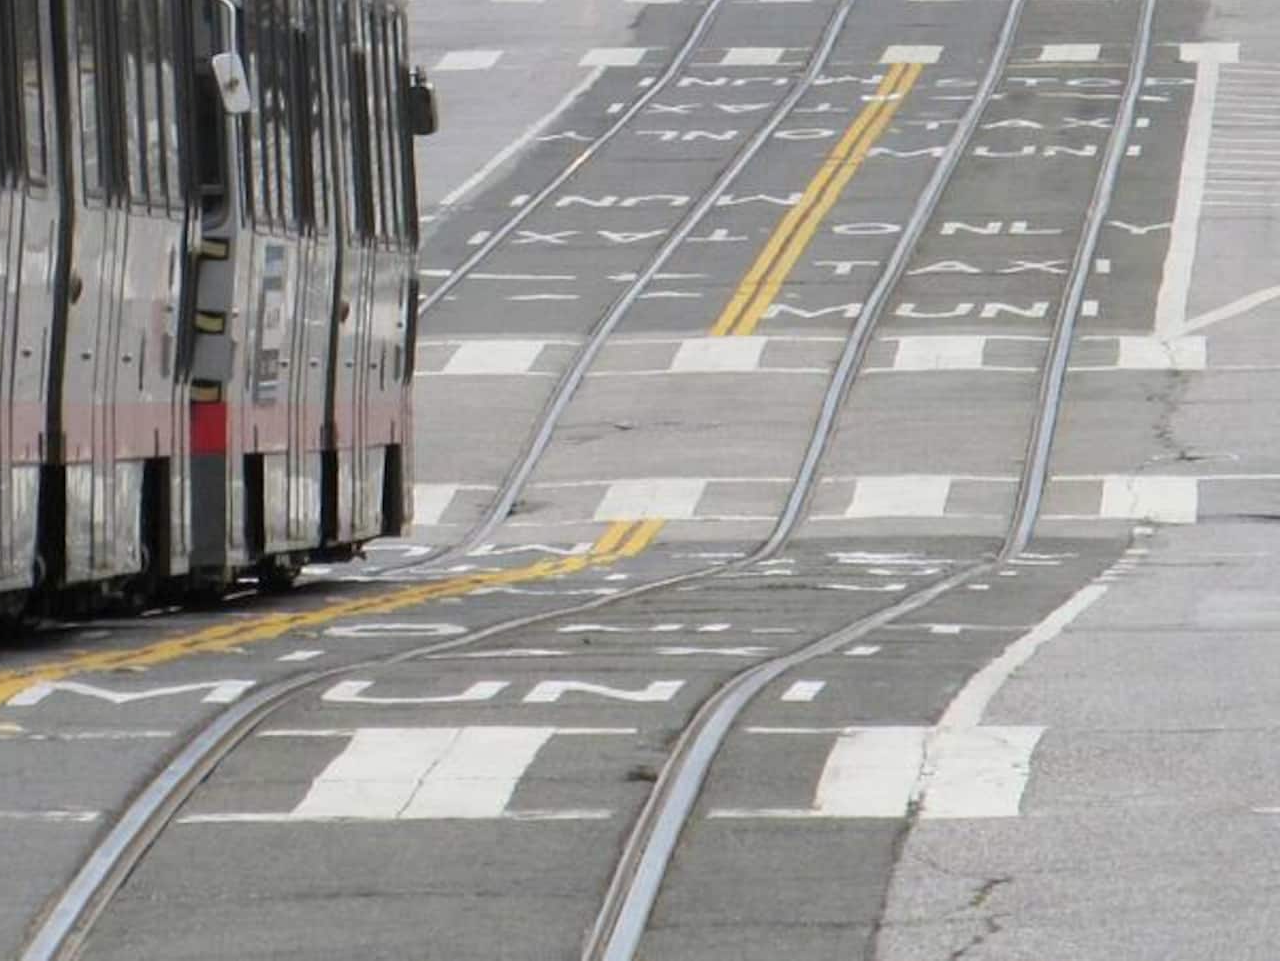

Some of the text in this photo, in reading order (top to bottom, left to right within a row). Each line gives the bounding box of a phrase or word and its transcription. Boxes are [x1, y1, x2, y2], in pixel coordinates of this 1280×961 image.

[831, 221, 1173, 235] ONLY
[813, 259, 1111, 275] TAXI
[762, 302, 1100, 319] MUNI
[6, 679, 827, 707] MUNI
